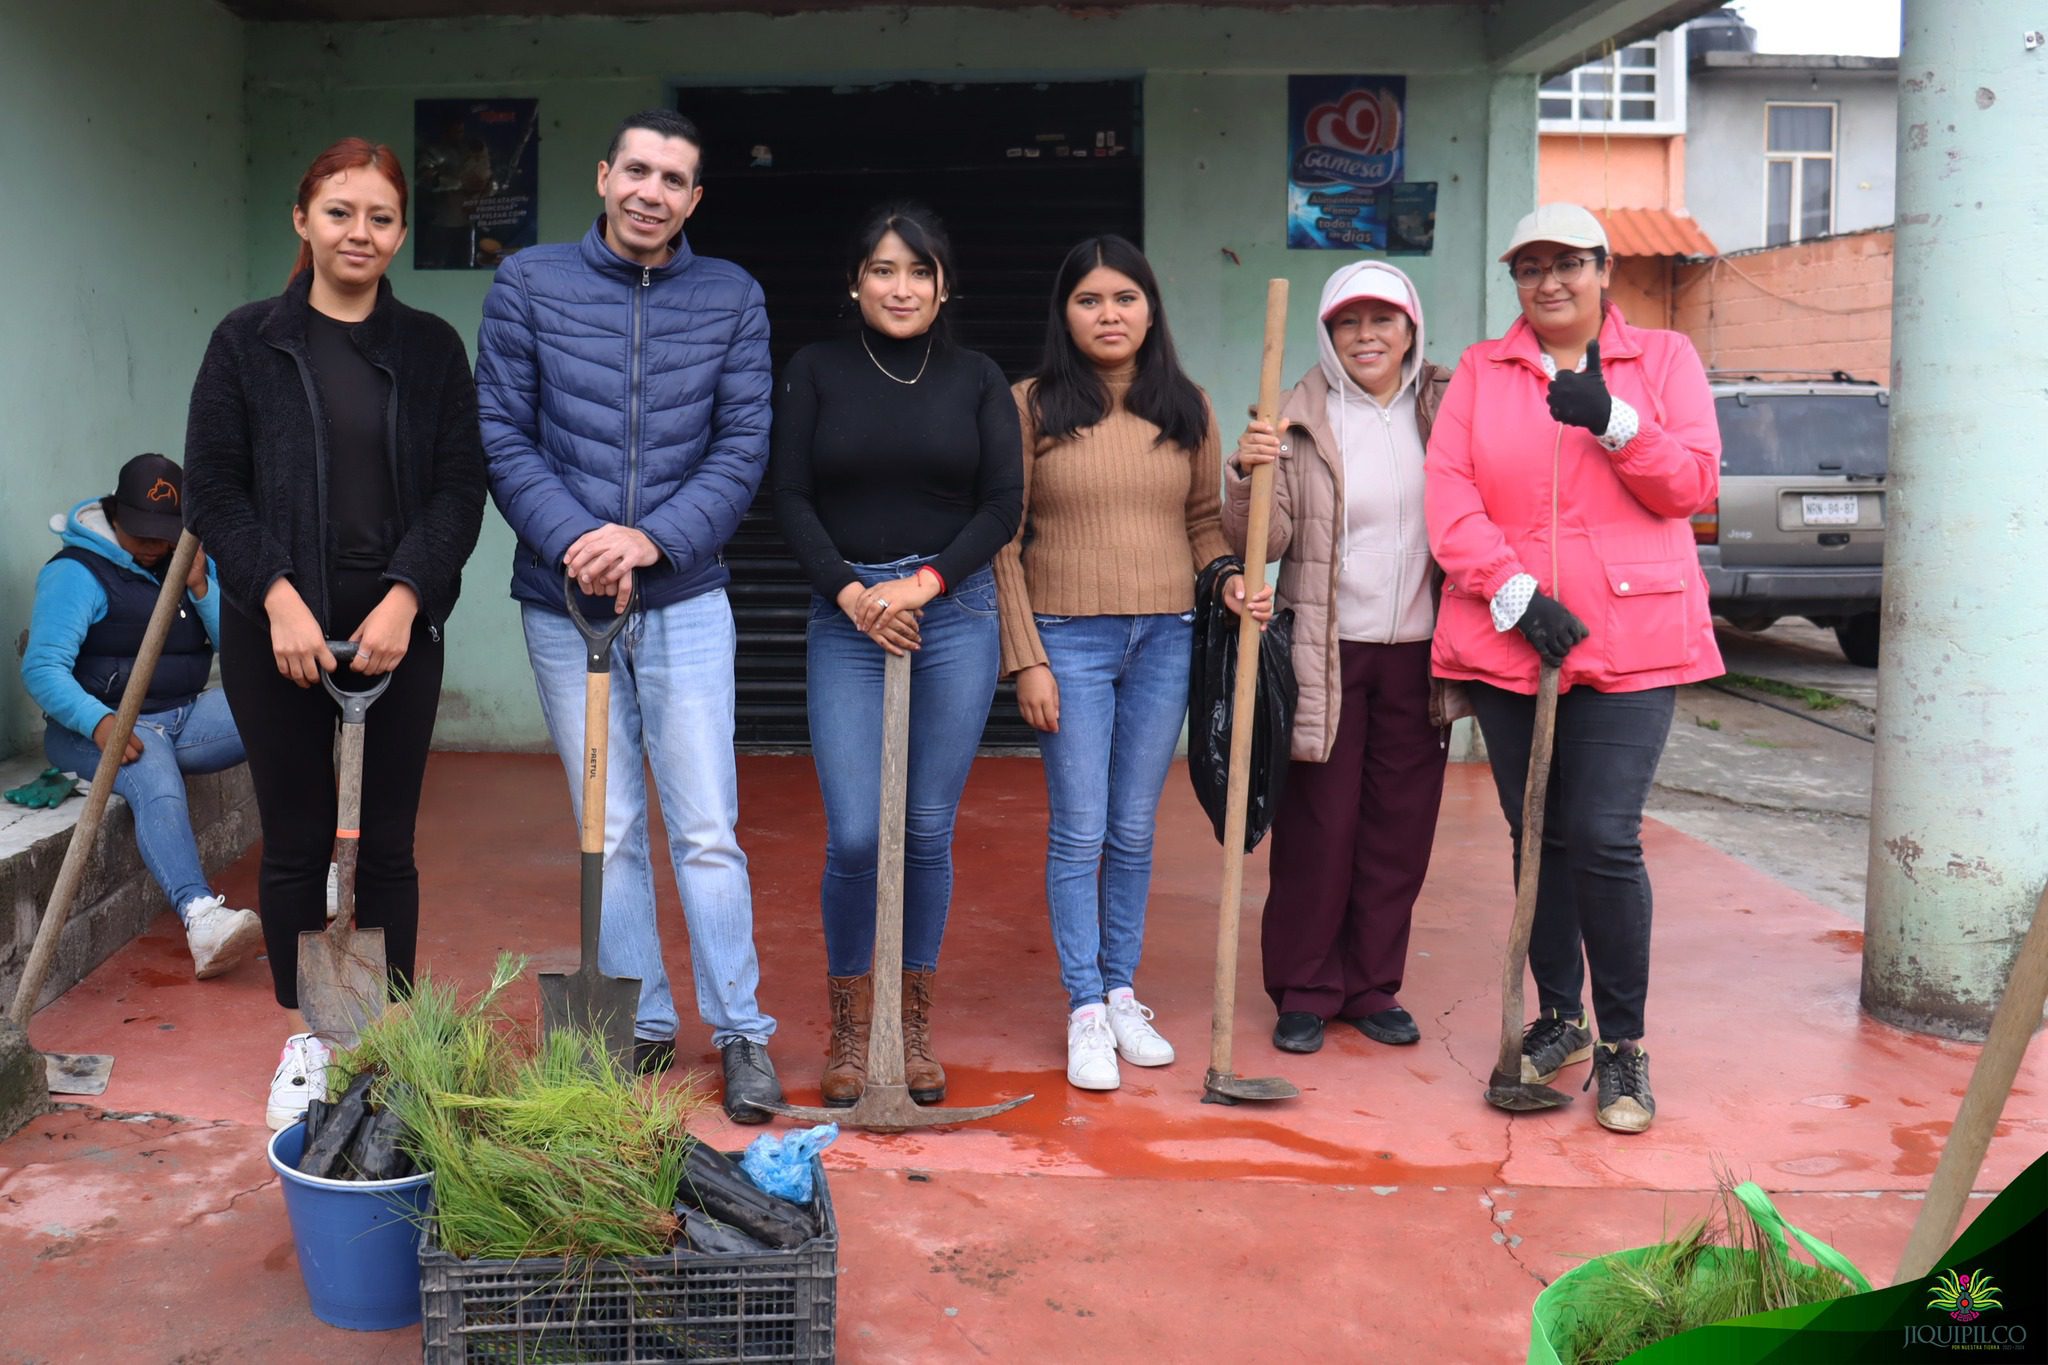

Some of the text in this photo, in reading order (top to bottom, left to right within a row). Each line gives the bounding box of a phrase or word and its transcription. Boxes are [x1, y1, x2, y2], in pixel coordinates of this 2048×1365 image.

[1303, 150, 1384, 177] Gamesa
[1319, 219, 1352, 229] todos
[1727, 529, 1753, 541] Jeep
